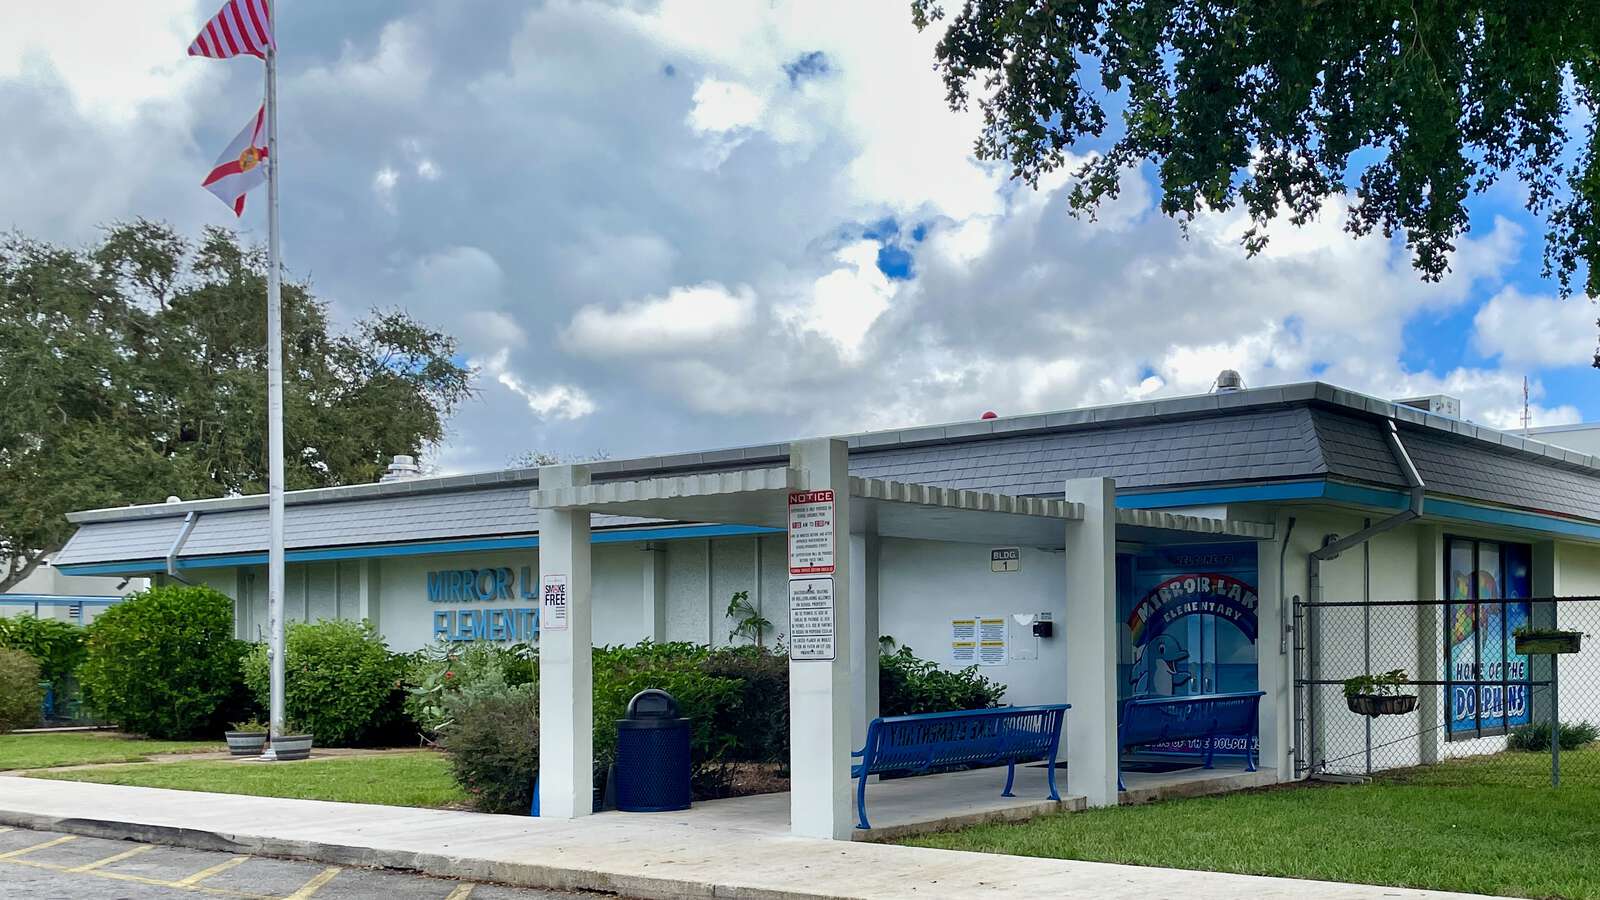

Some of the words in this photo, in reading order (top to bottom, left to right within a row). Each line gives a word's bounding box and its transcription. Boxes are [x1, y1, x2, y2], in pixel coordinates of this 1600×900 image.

[790, 492, 832, 503] NOTICE
[1003, 561, 1008, 570] 1
[427, 567, 515, 601] MIRROR
[520, 566, 539, 599] L
[545, 594, 565, 606] FREE
[1137, 577, 1210, 623] MIRROR
[1163, 601, 1242, 622] ELEMENTARY
[1456, 685, 1525, 720] DOPHNS
[1214, 738, 1259, 750] DOLPHNS
